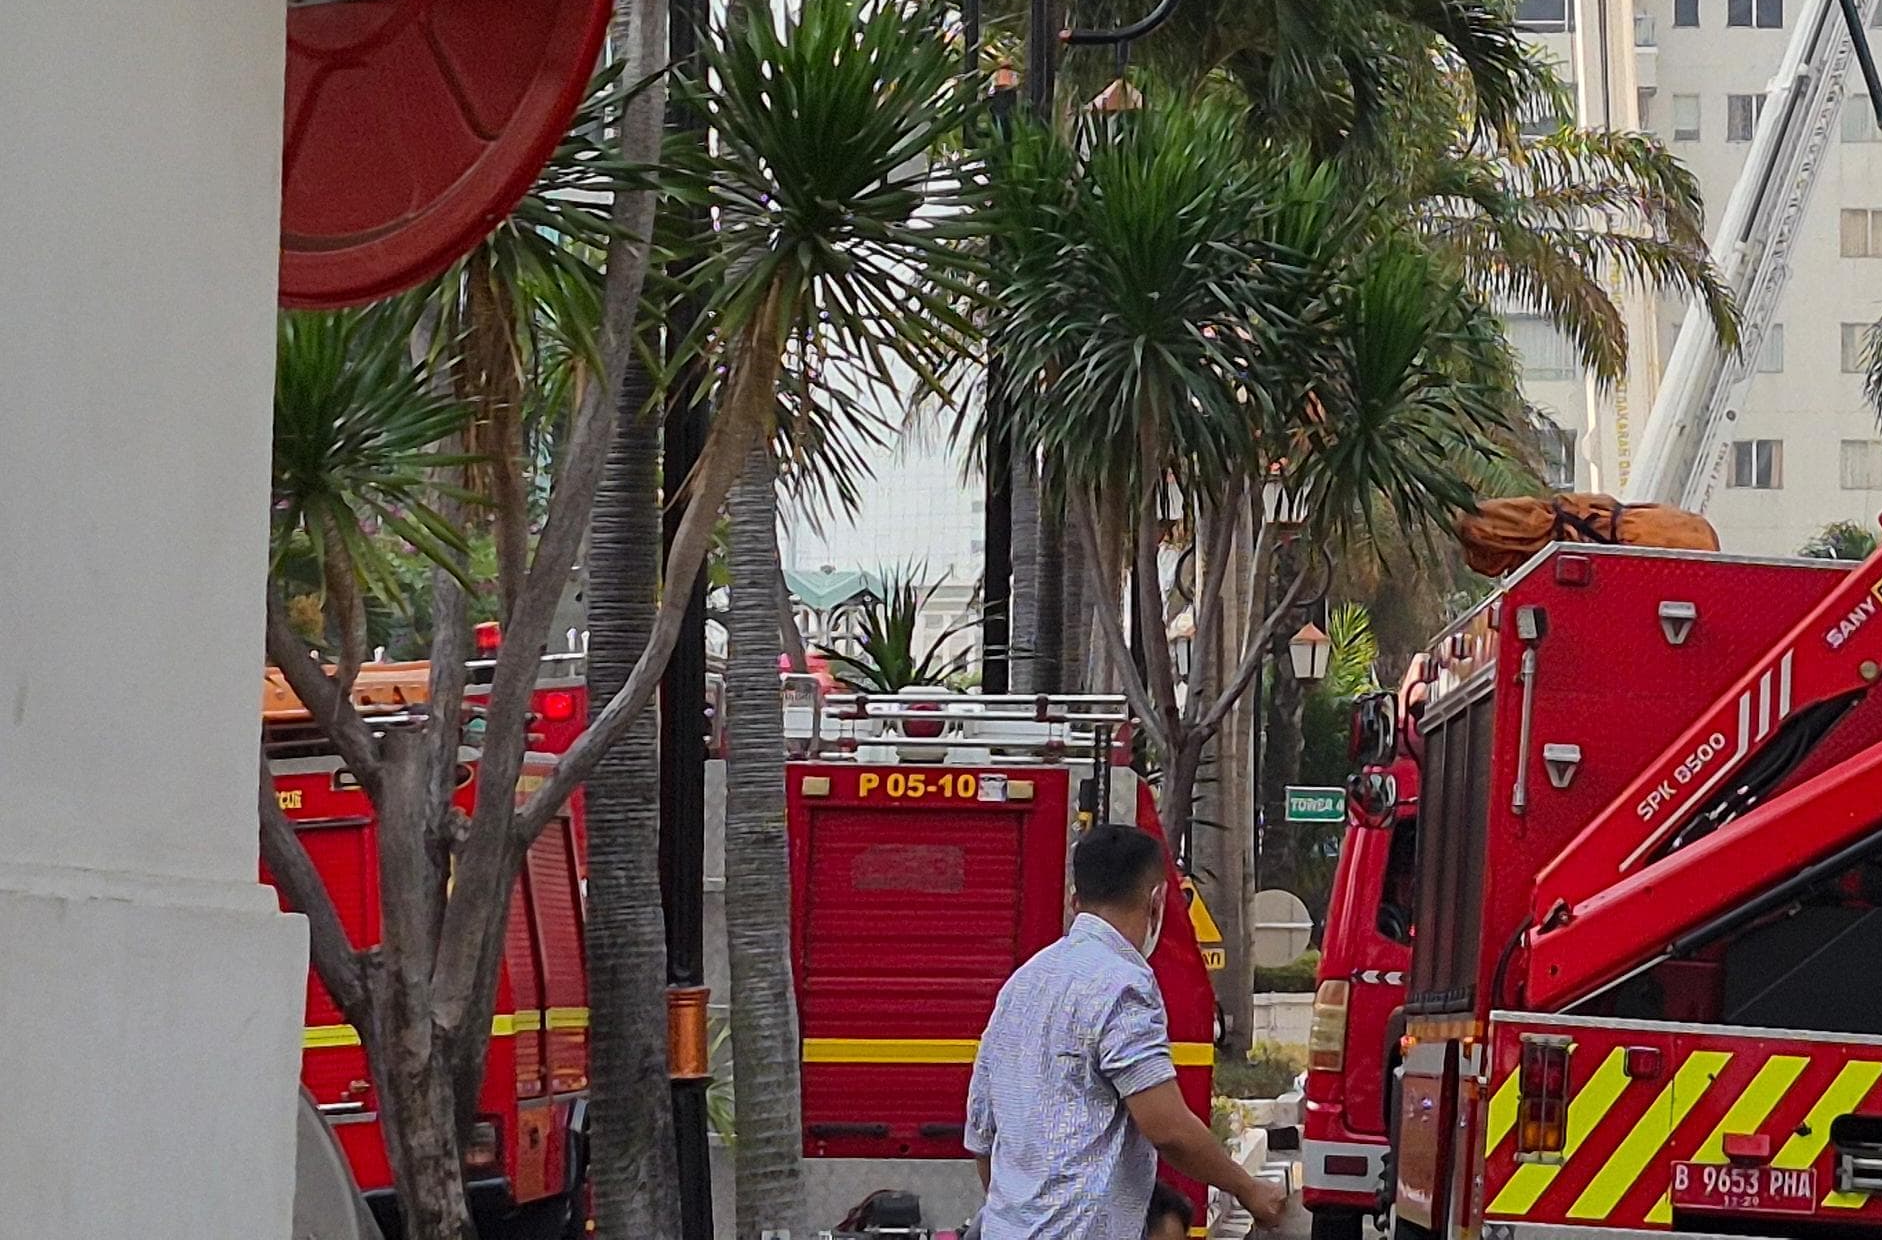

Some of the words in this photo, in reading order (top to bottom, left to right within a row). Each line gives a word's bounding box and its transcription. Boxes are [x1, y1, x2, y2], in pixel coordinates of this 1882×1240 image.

[1826, 595, 1876, 649] SANY
[859, 773, 880, 797] P
[886, 773, 976, 798] 05-10
[1636, 779, 1677, 822] SPK
[1673, 732, 1726, 784] 8500
[1674, 1164, 1689, 1191] B
[1703, 1166, 1760, 1196] 9653
[1769, 1170, 1812, 1198] PHA
